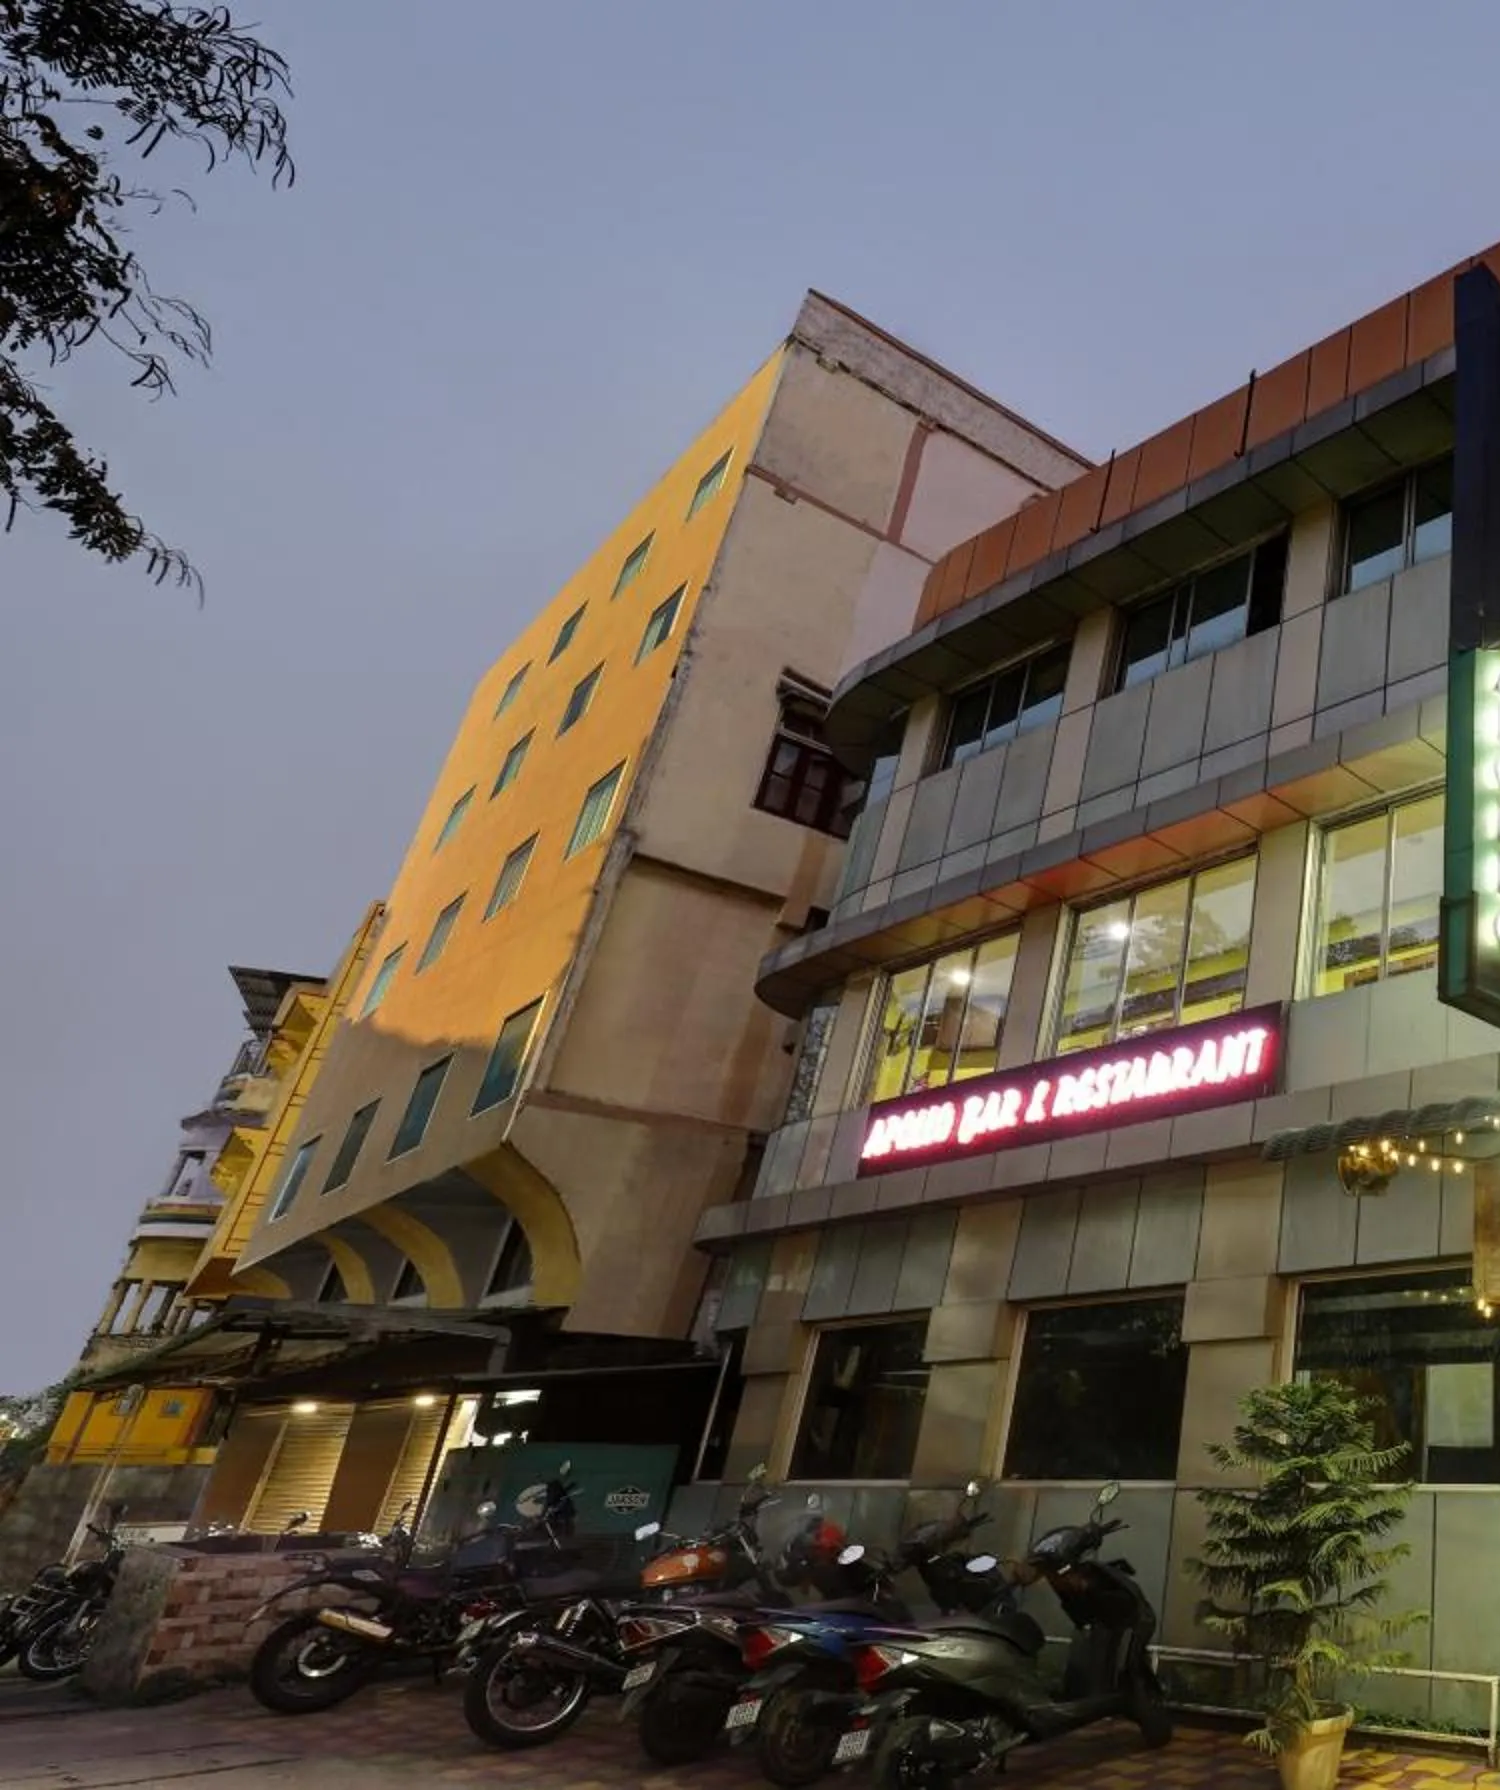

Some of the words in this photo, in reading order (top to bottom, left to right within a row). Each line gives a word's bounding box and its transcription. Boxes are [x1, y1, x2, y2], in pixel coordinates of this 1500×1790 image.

[958, 1087, 1021, 1142] BAR
[1026, 1080, 1049, 1121] &
[1053, 1029, 1266, 1115] RESTAURANT
